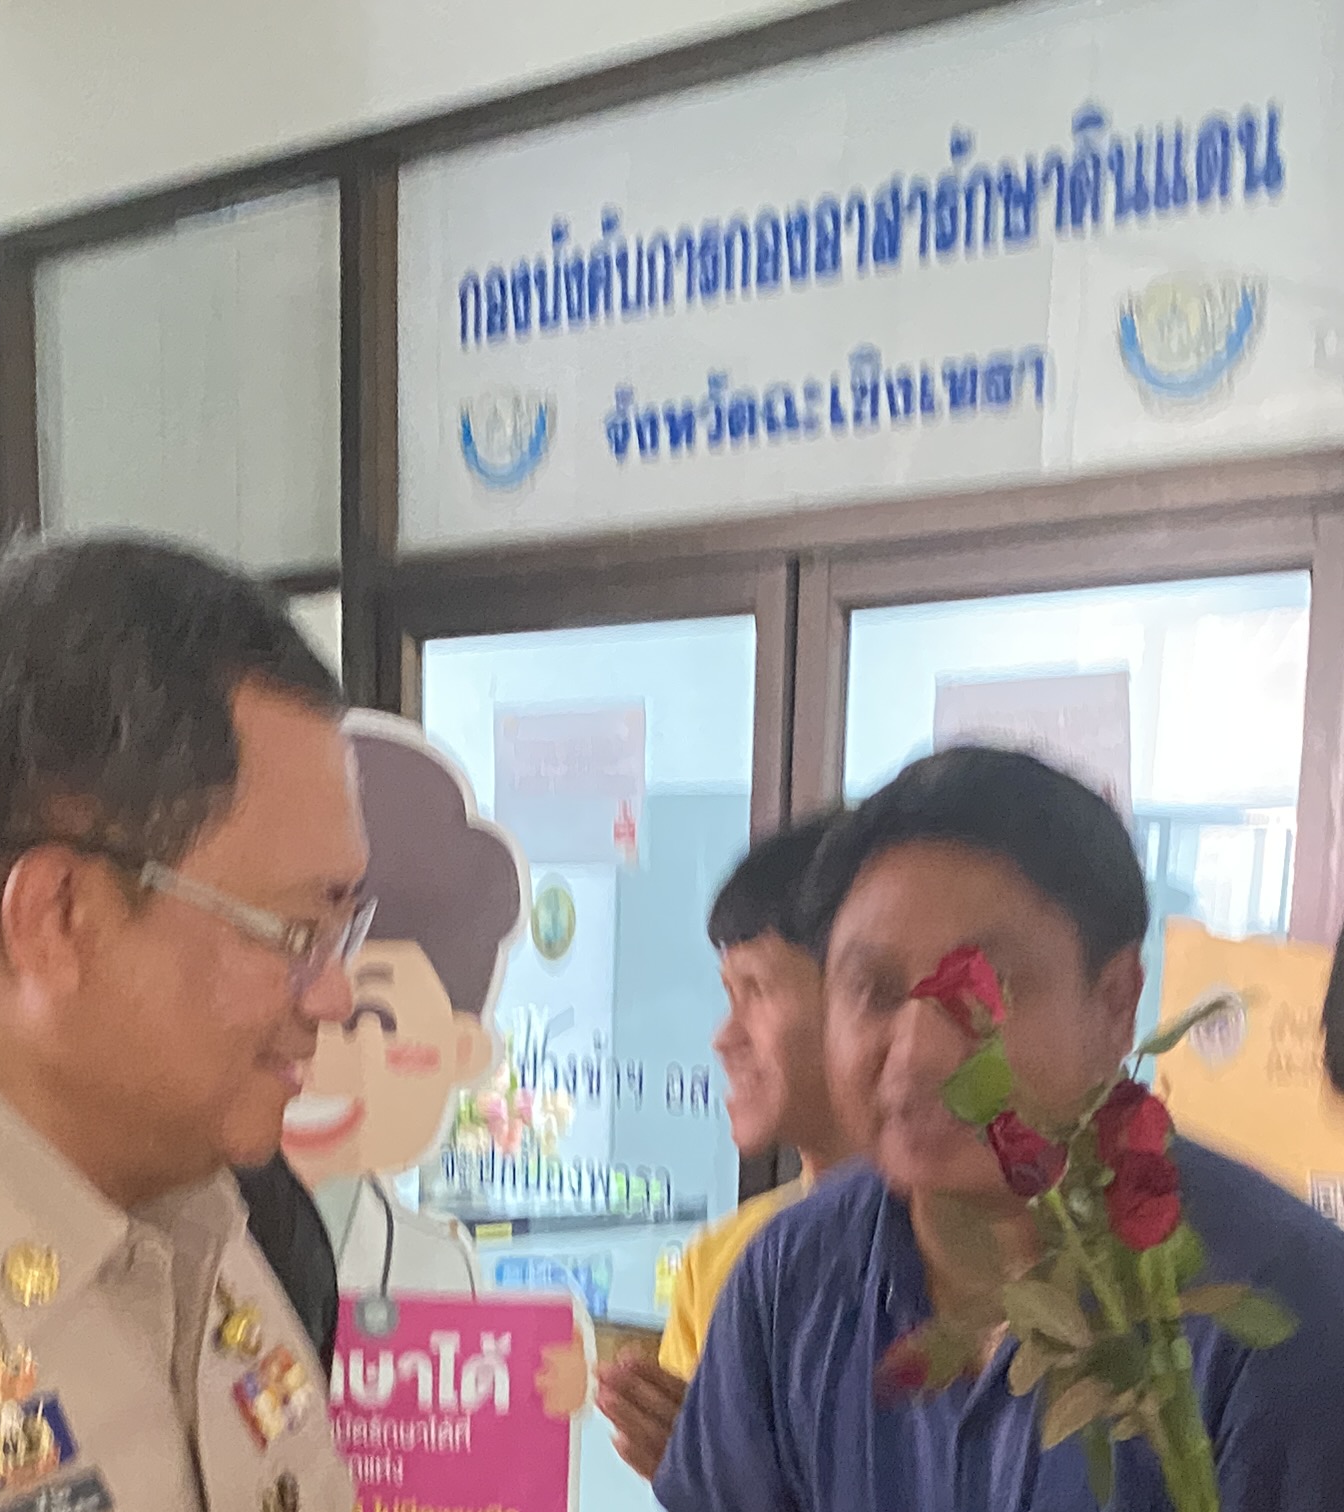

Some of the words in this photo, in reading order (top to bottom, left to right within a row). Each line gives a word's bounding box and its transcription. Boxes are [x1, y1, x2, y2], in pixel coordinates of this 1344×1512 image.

[458, 98, 1286, 352] กองบังคับการกองอาสารักษาดินแดน
